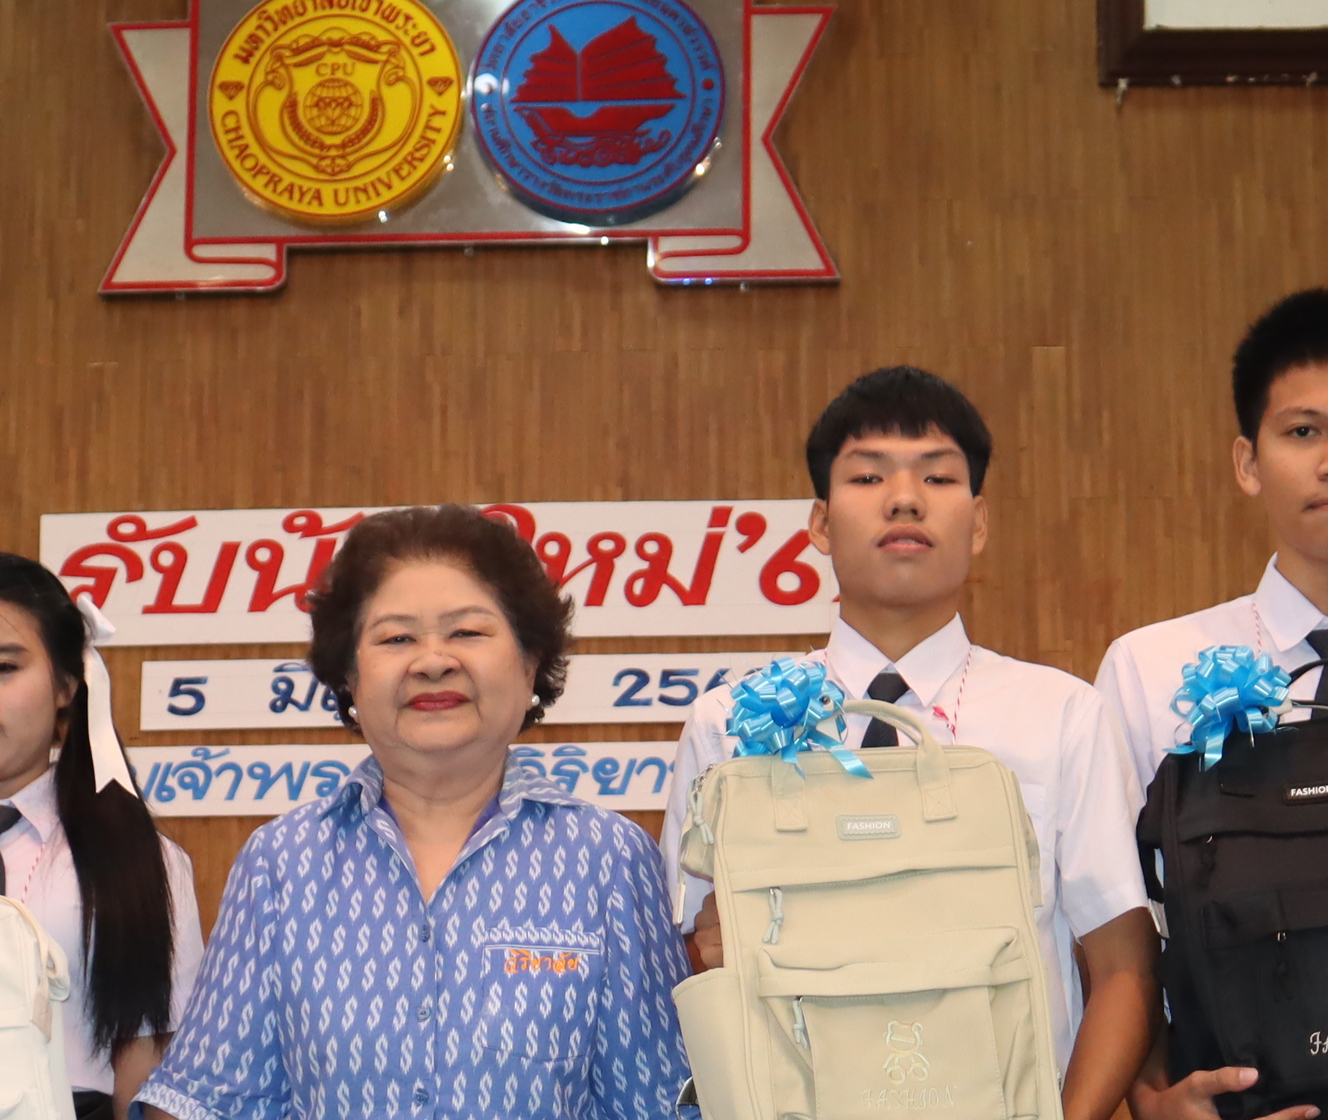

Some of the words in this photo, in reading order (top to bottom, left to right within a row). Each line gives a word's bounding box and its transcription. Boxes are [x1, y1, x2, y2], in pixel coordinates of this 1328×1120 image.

[233, 0, 437, 64] มหาวิทยาลยเจาพระยา
[315, 62, 357, 77] CPU
[221, 109, 324, 207] CHAOPRAYA
[333, 104, 448, 207] UNIVERSITY
[167, 676, 209, 717] 5
[847, 820, 891, 831] FASHION
